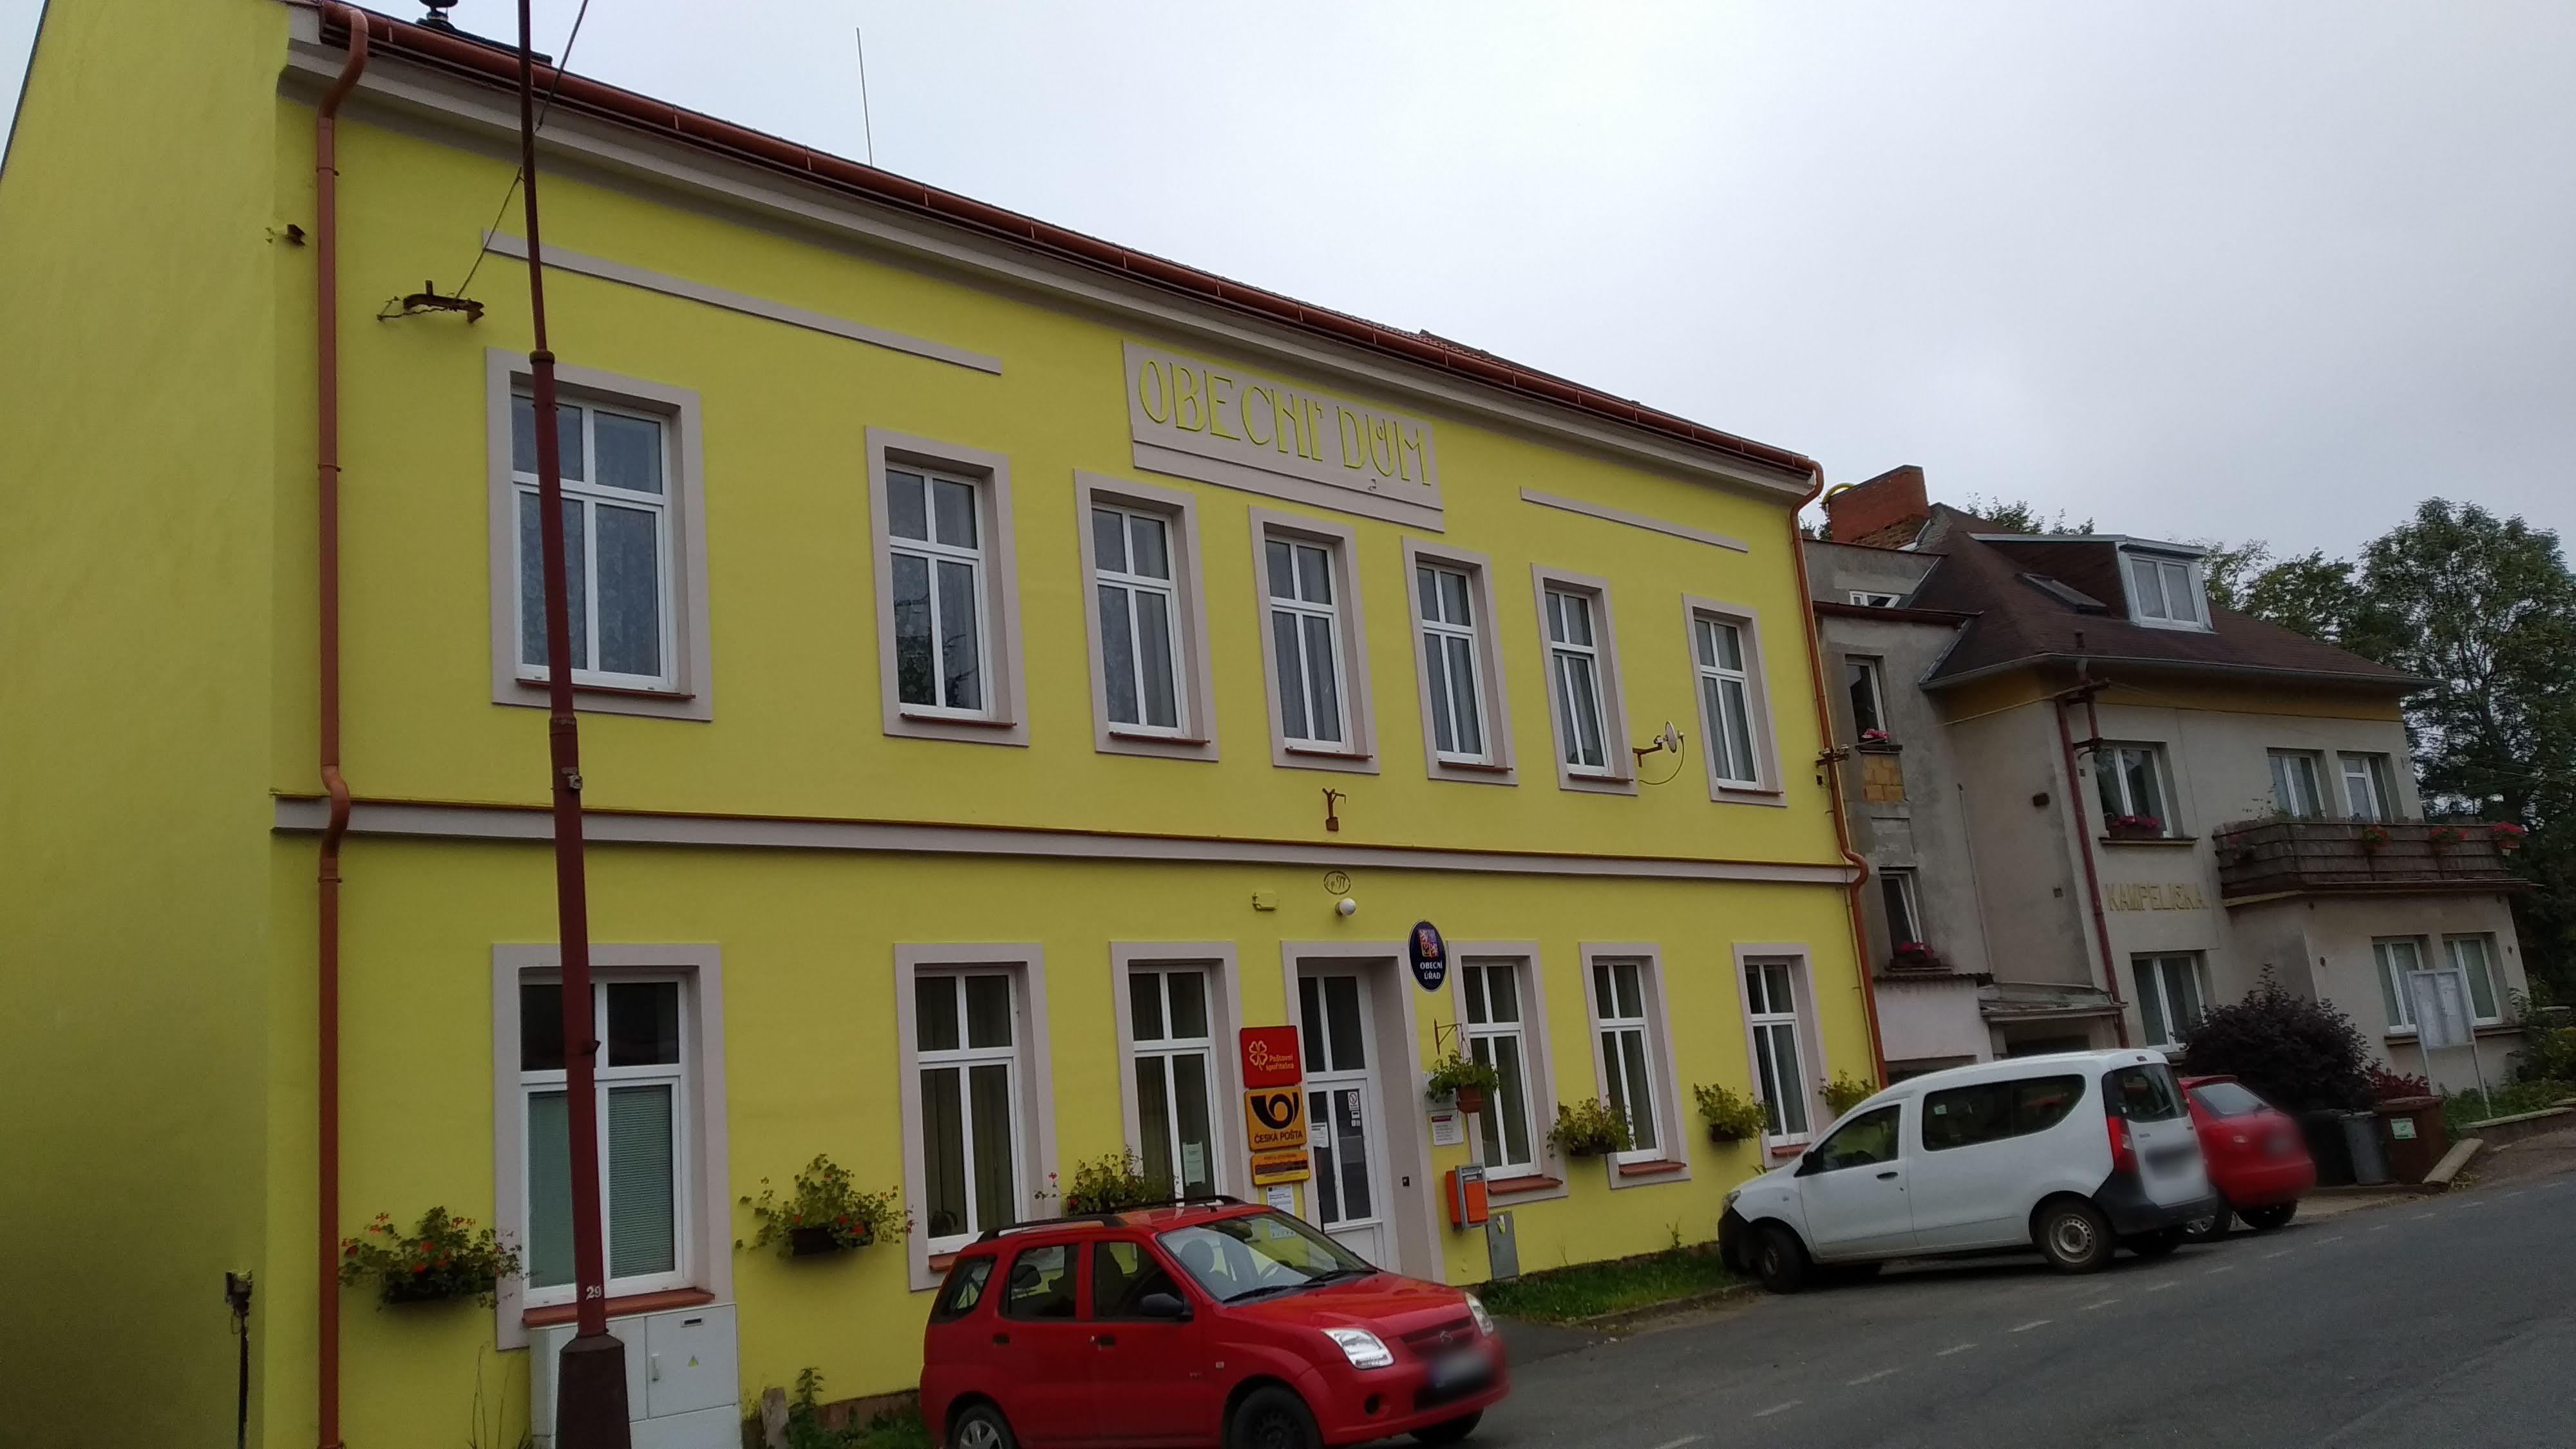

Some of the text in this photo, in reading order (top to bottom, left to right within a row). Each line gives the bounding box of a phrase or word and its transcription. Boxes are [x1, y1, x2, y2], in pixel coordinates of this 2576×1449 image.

[1139, 361, 1432, 486] OBECNÍ DŮM
[1419, 960, 1443, 969] OBECNÍ
[1424, 971, 1441, 980] ÚŘAD
[1280, 1130, 1303, 1141] POŠTA
[586, 1285, 601, 1300] 29
